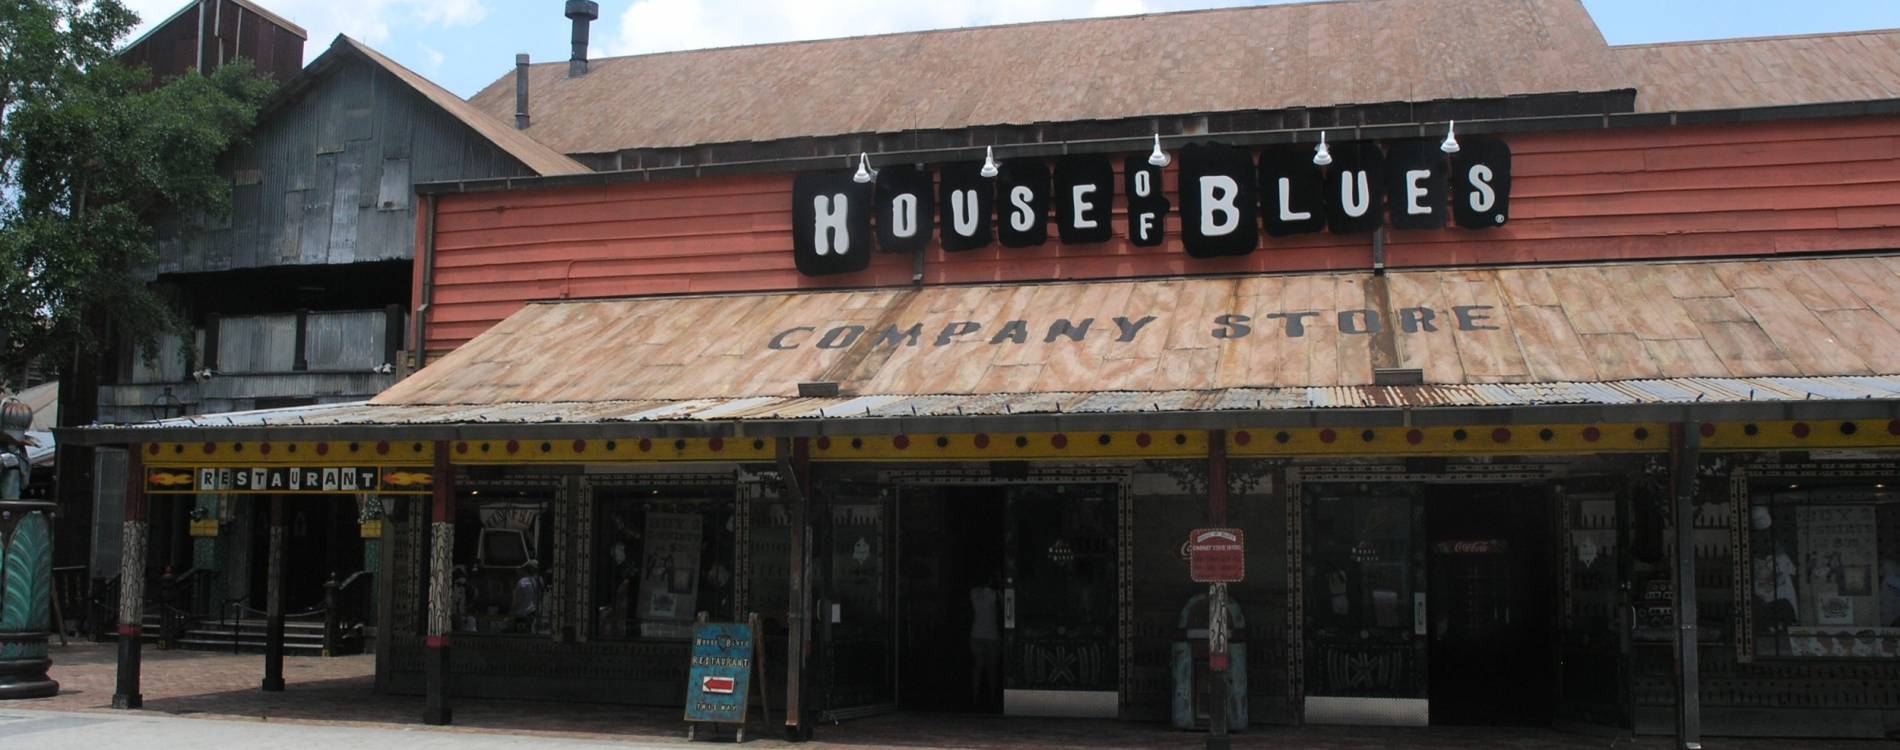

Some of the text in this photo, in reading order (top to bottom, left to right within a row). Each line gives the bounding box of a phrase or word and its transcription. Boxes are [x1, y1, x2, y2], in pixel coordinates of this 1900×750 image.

[813, 164, 1496, 256] HOUSE OF BLUES
[767, 305, 1500, 350] COMPANY STORE
[203, 470, 375, 487] RESTAURANT
[693, 656, 749, 668] RESTAURANT
